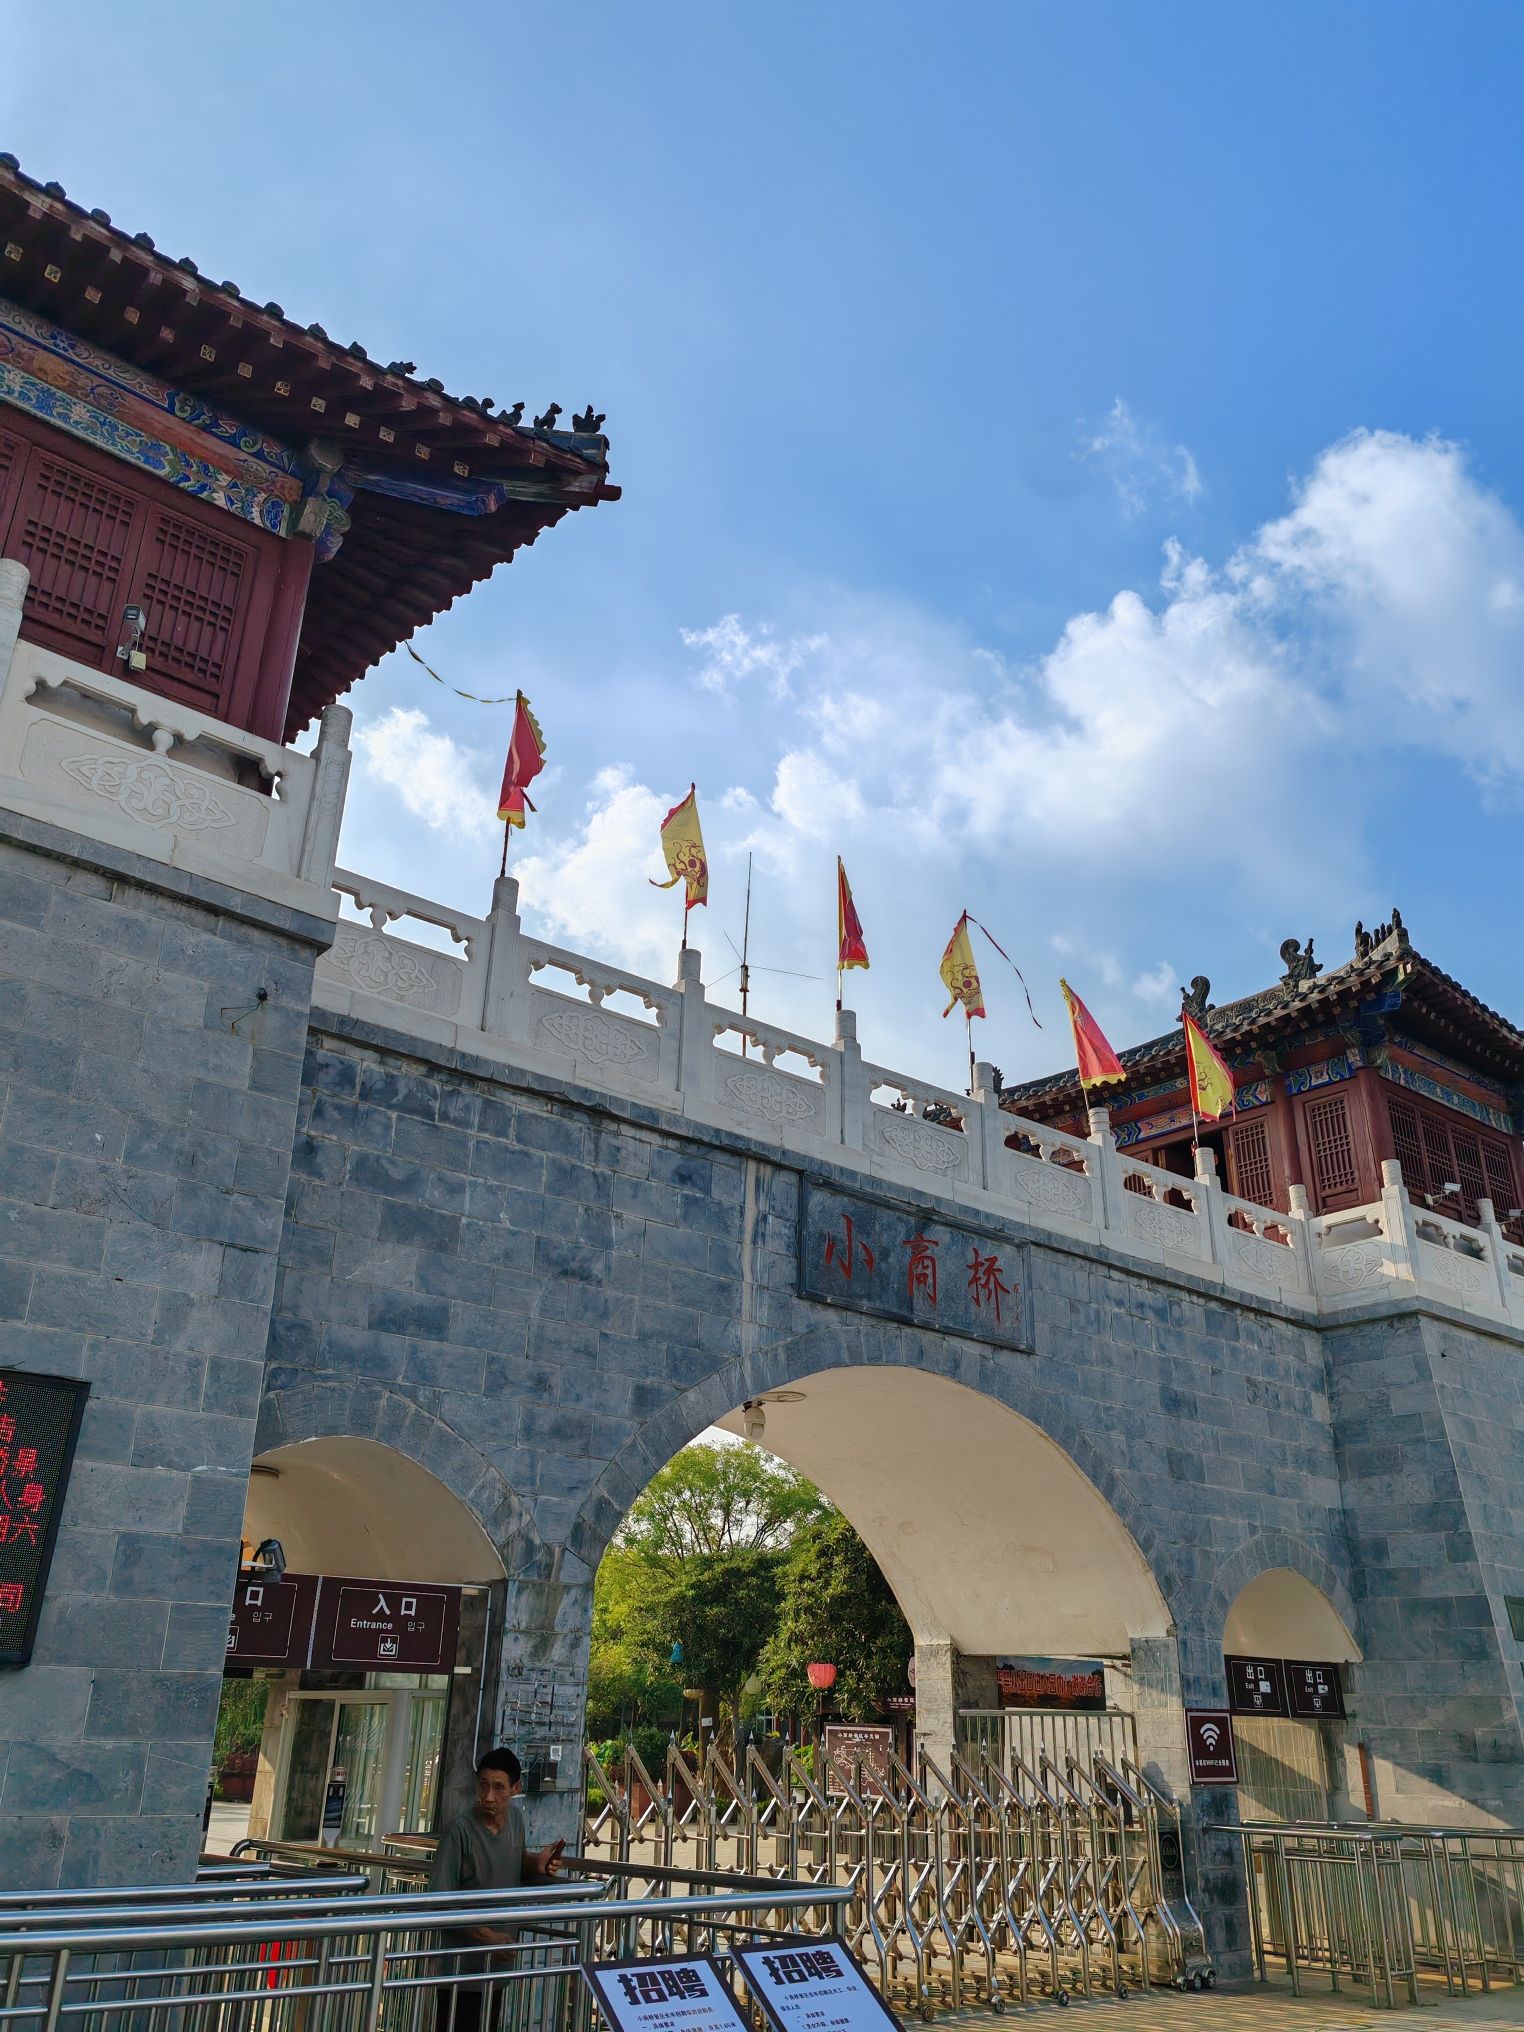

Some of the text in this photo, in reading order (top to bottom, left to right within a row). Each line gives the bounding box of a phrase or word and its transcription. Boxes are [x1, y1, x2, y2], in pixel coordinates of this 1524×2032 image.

[824, 1212, 1011, 1323] 小商桥
[371, 1593, 417, 1617] 入口
[252, 1611, 273, 1623] 입구
[350, 1618, 393, 1631] Entrance
[407, 1620, 426, 1632] 입구
[1245, 1664, 1265, 1680] 出口
[1305, 1668, 1324, 1684] 出口
[1245, 1682, 1255, 1690] Exit
[761, 1950, 845, 1985] 招聘
[617, 1968, 709, 2005] 招聘
